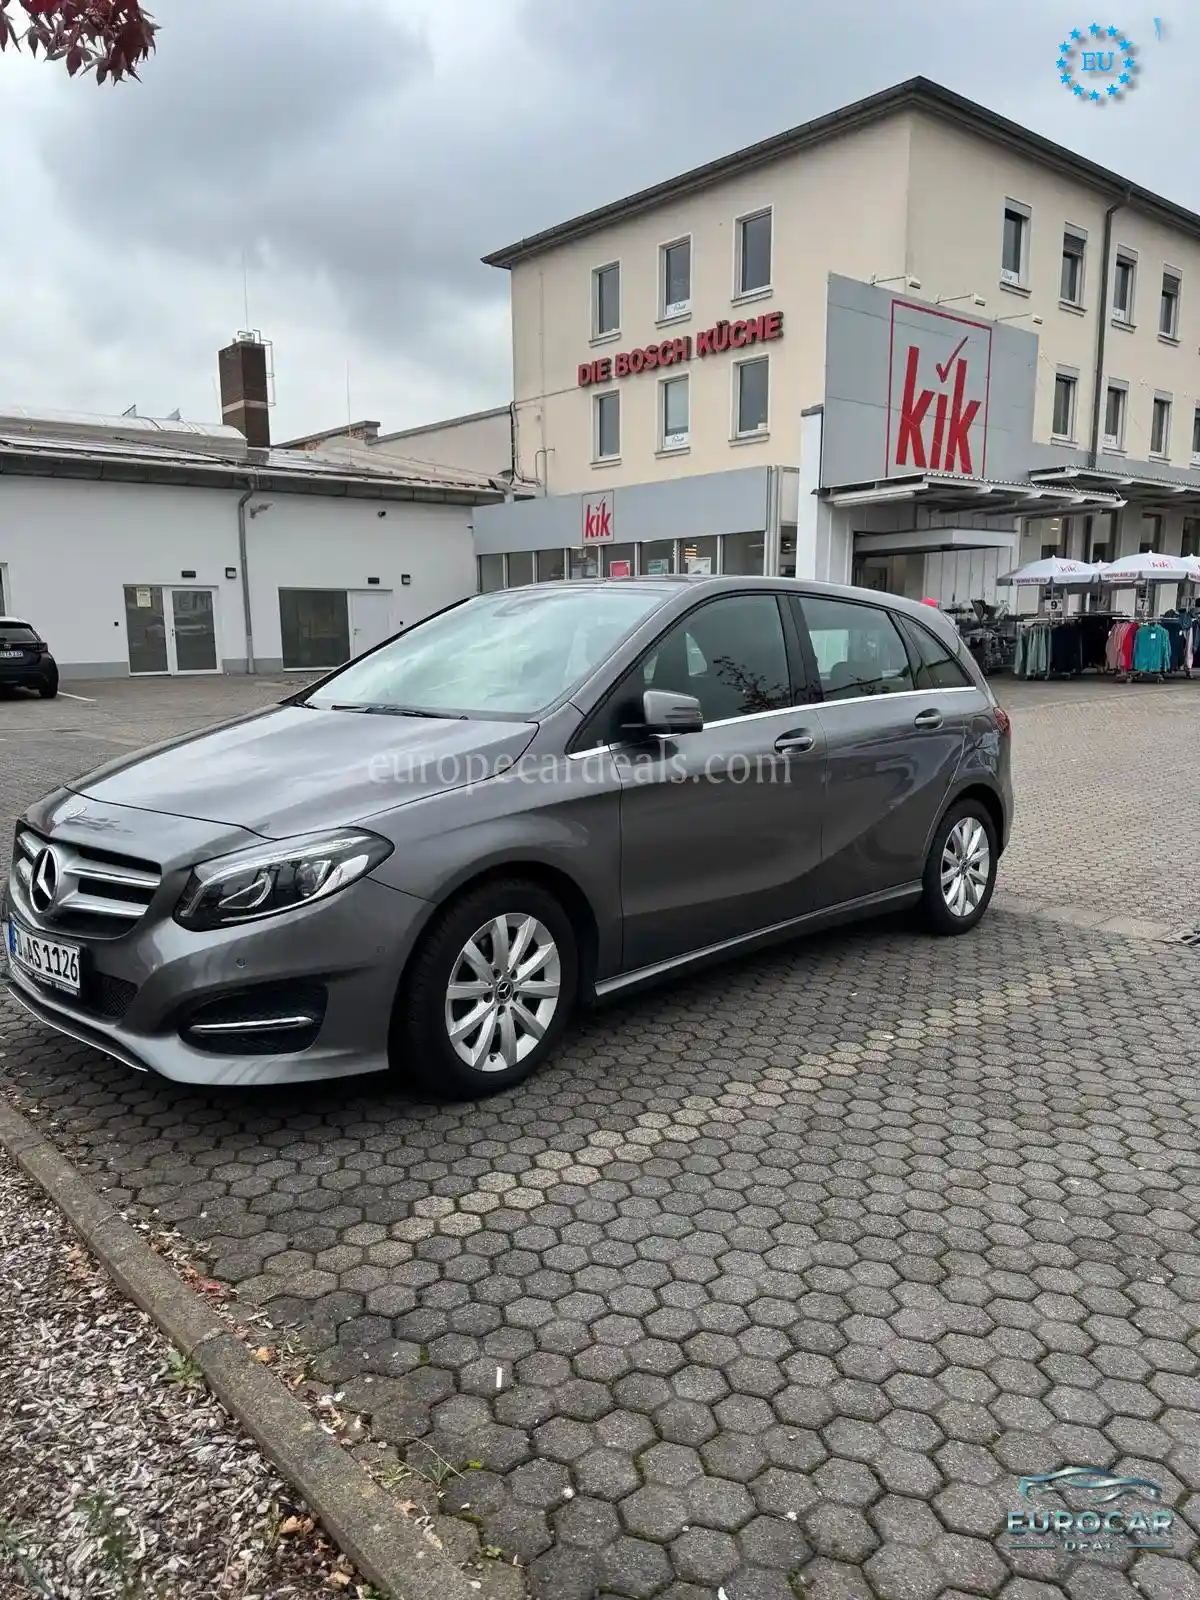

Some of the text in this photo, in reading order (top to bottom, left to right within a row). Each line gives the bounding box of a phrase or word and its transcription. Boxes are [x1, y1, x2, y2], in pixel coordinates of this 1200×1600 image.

[577, 311, 784, 387] DIE BOSCH KÜCHE
[896, 338, 982, 475] kik
[584, 496, 612, 539] kik
[43, 944, 78, 982] 1126
